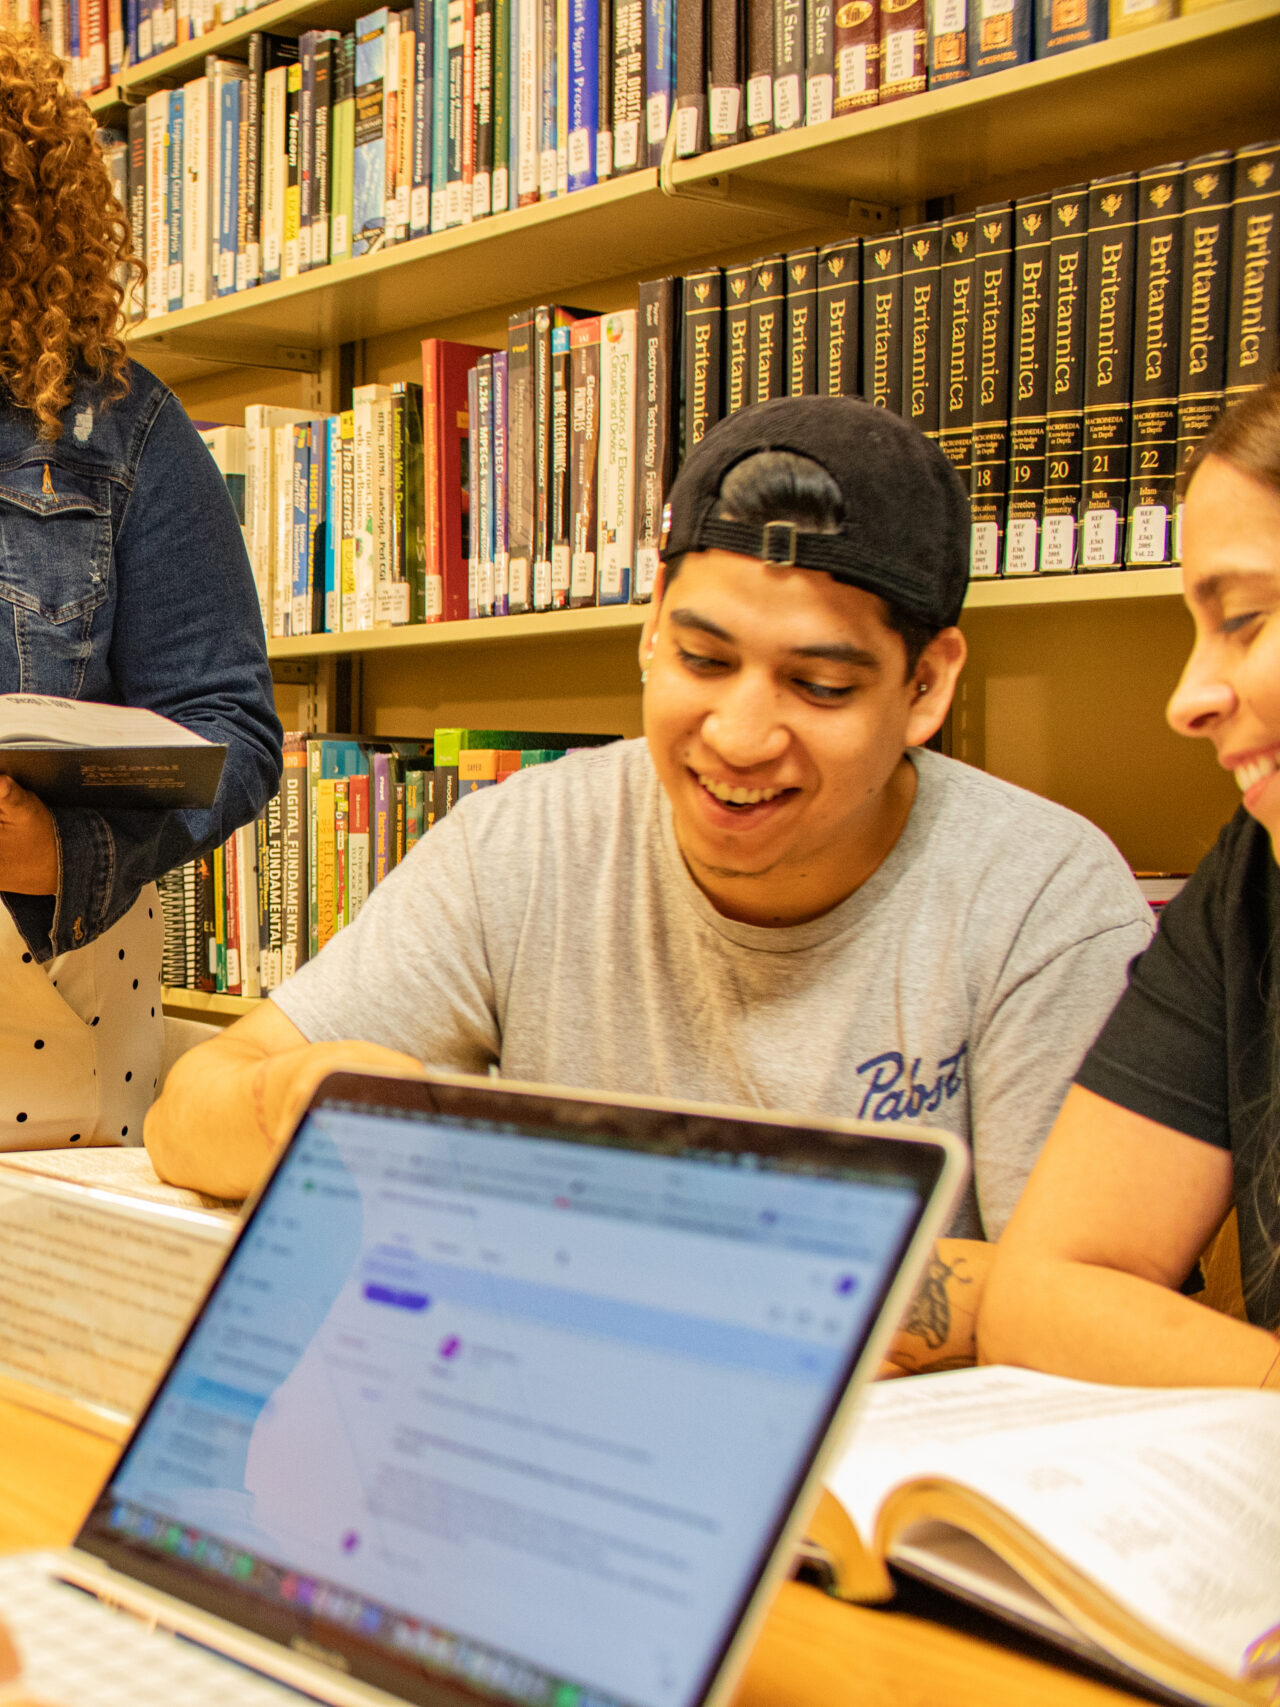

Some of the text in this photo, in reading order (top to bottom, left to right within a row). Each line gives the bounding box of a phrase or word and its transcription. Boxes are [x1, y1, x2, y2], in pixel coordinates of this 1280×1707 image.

[573, 27, 584, 72] Signal
[656, 27, 664, 70] Processing
[784, 14, 798, 62] States
[816, 6, 830, 55] States
[615, 5, 629, 127] SIGNAL PROCESSI
[627, 3, 642, 123] HANDS-ON DIGITA
[414, 42, 425, 183] Digital Signal Processing
[479, 90, 489, 125] DIGITAL
[288, 112, 299, 167] Telecom
[399, 117, 407, 175] Processing
[170, 119, 182, 252] Engineering Circuit Analysis
[1097, 242, 1123, 387] Britannica
[1145, 233, 1173, 381] Britannica
[1189, 224, 1220, 375] Britannica
[1239, 213, 1274, 368] Britannica
[828, 299, 846, 398] Britanni
[874, 292, 893, 408] Britannic
[912, 284, 931, 417] Britannica
[949, 276, 970, 412] Britannica
[981, 268, 1003, 406] Britannica
[1018, 260, 1042, 400] Britannica
[1055, 251, 1079, 395] Britannica
[730, 320, 747, 414] Britann
[757, 312, 775, 404] Britann
[792, 306, 808, 398] Britann
[479, 376, 488, 412] H.264
[538, 340, 546, 422] COMMUNICATION
[574, 387, 585, 432] PRINCIPLES
[585, 375, 594, 440] Electronic
[609, 355, 619, 464] Circuits and Devices
[693, 323, 711, 445] Britannica
[378, 412, 386, 441] HTML,
[479, 427, 489, 476] MPEG-4
[495, 428, 503, 474] VIDEO
[554, 390, 566, 473] BASIC ELECTRONICS
[616, 353, 629, 526] Foundations of Electronics
[644, 337, 658, 544] Electronics Technology Fundamenta
[1056, 437, 1072, 445] Depth
[1089, 424, 1117, 432] Knowledge
[1098, 431, 1114, 439] Depth
[1138, 420, 1166, 428] Knowledge
[1147, 426, 1162, 434] Depth
[393, 408, 403, 533] Learning Web Design
[515, 379, 525, 533] Electronics Fundamentals
[977, 469, 991, 487] 18
[1014, 465, 1031, 482] 19
[1049, 461, 1070, 479] 20
[1093, 455, 1109, 472] 21
[1140, 450, 1159, 468] 22
[294, 462, 302, 508] Smarter
[310, 464, 318, 509] INSIDE
[343, 442, 354, 536] The Internet
[378, 485, 386, 538] JavaScript,
[1089, 499, 1110, 509] Ireland
[1092, 490, 1108, 499] India
[1139, 486, 1157, 496] Islam
[1141, 496, 1155, 505] Life
[344, 552, 354, 593] DUMM
[269, 794, 281, 836] GITAL
[287, 779, 298, 836] DIGITAL
[397, 822, 402, 830] TO
[377, 812, 386, 882] Electronic Devic
[324, 840, 334, 939] ELECTRON
[856, 1040, 968, 1121] Pabst
